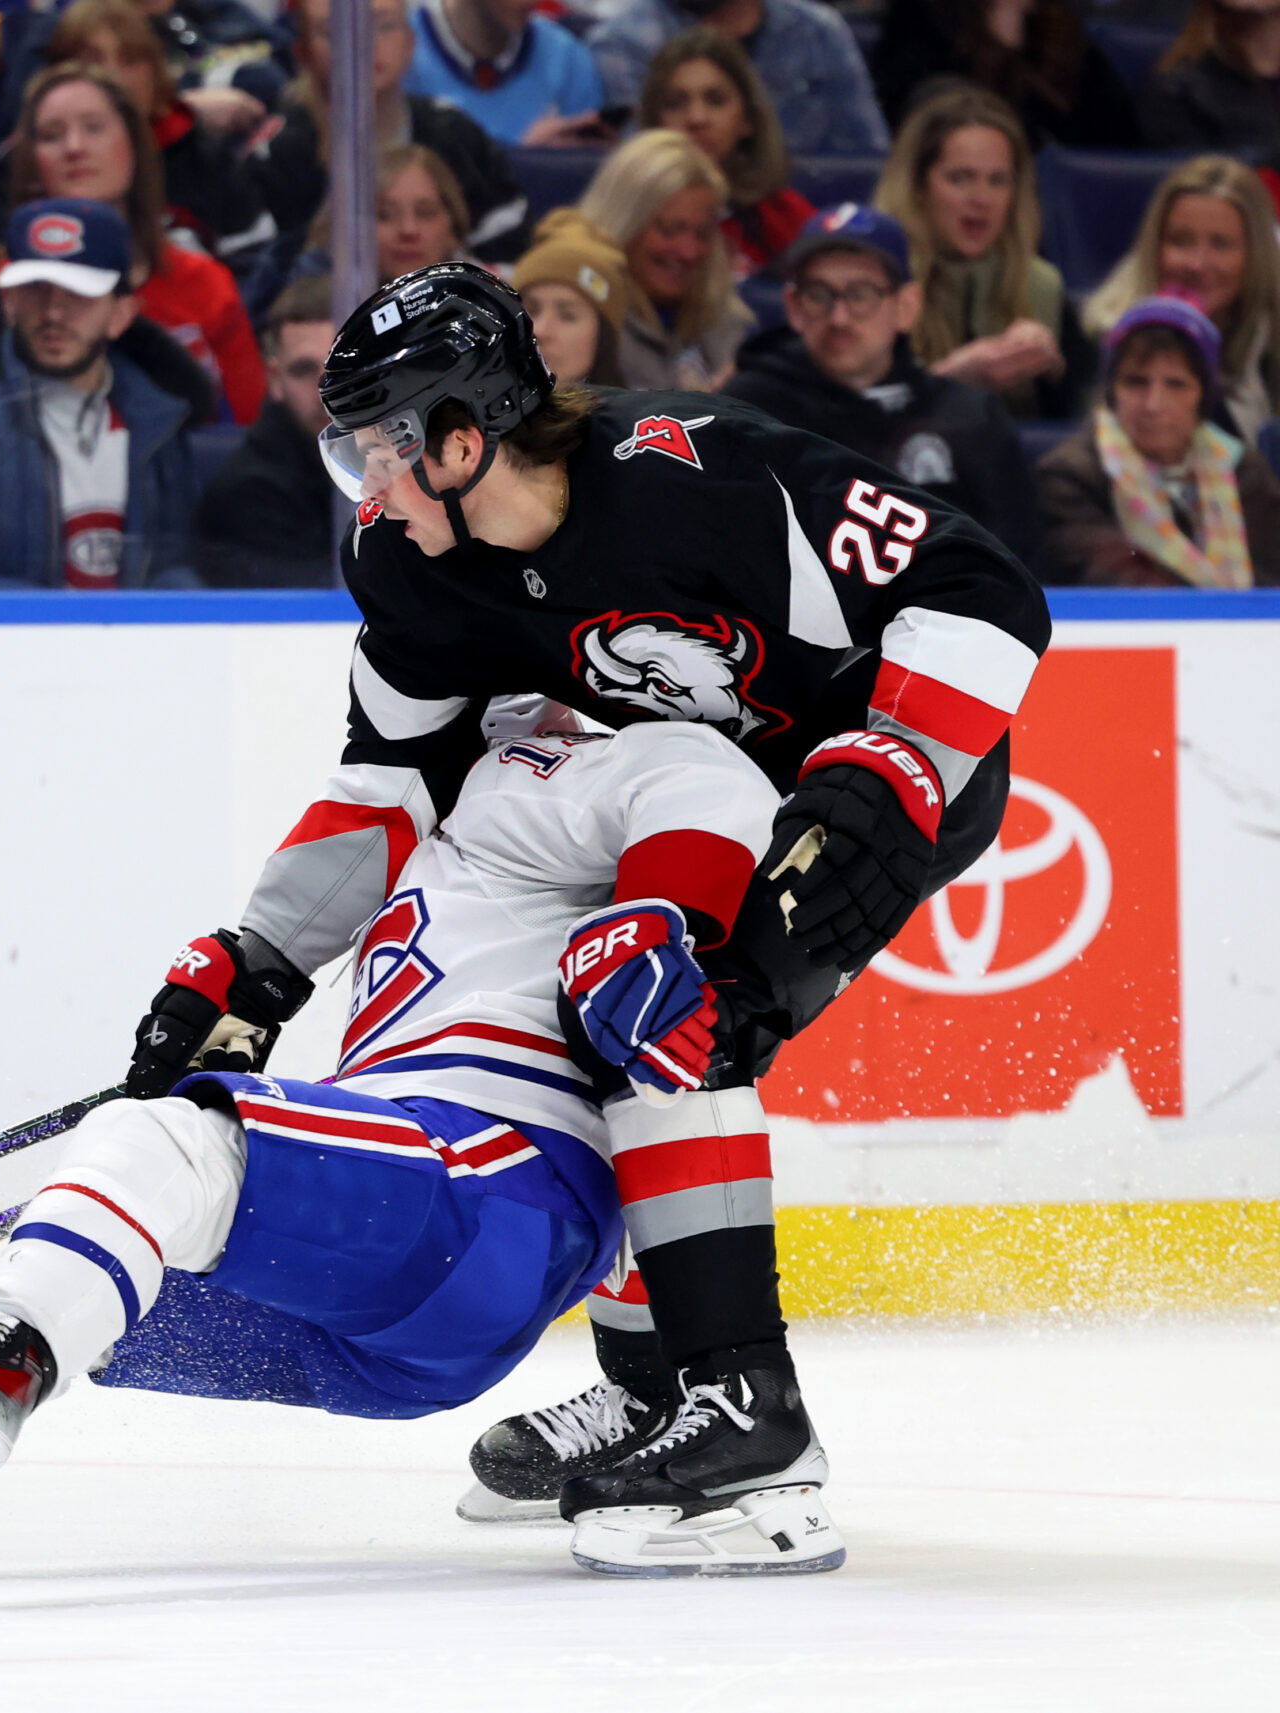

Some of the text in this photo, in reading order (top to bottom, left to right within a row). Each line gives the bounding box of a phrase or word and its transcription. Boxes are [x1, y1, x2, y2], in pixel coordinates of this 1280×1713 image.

[402, 286, 434, 304] Trusted
[403, 297, 427, 312] Nurse
[827, 478, 930, 588] 25
